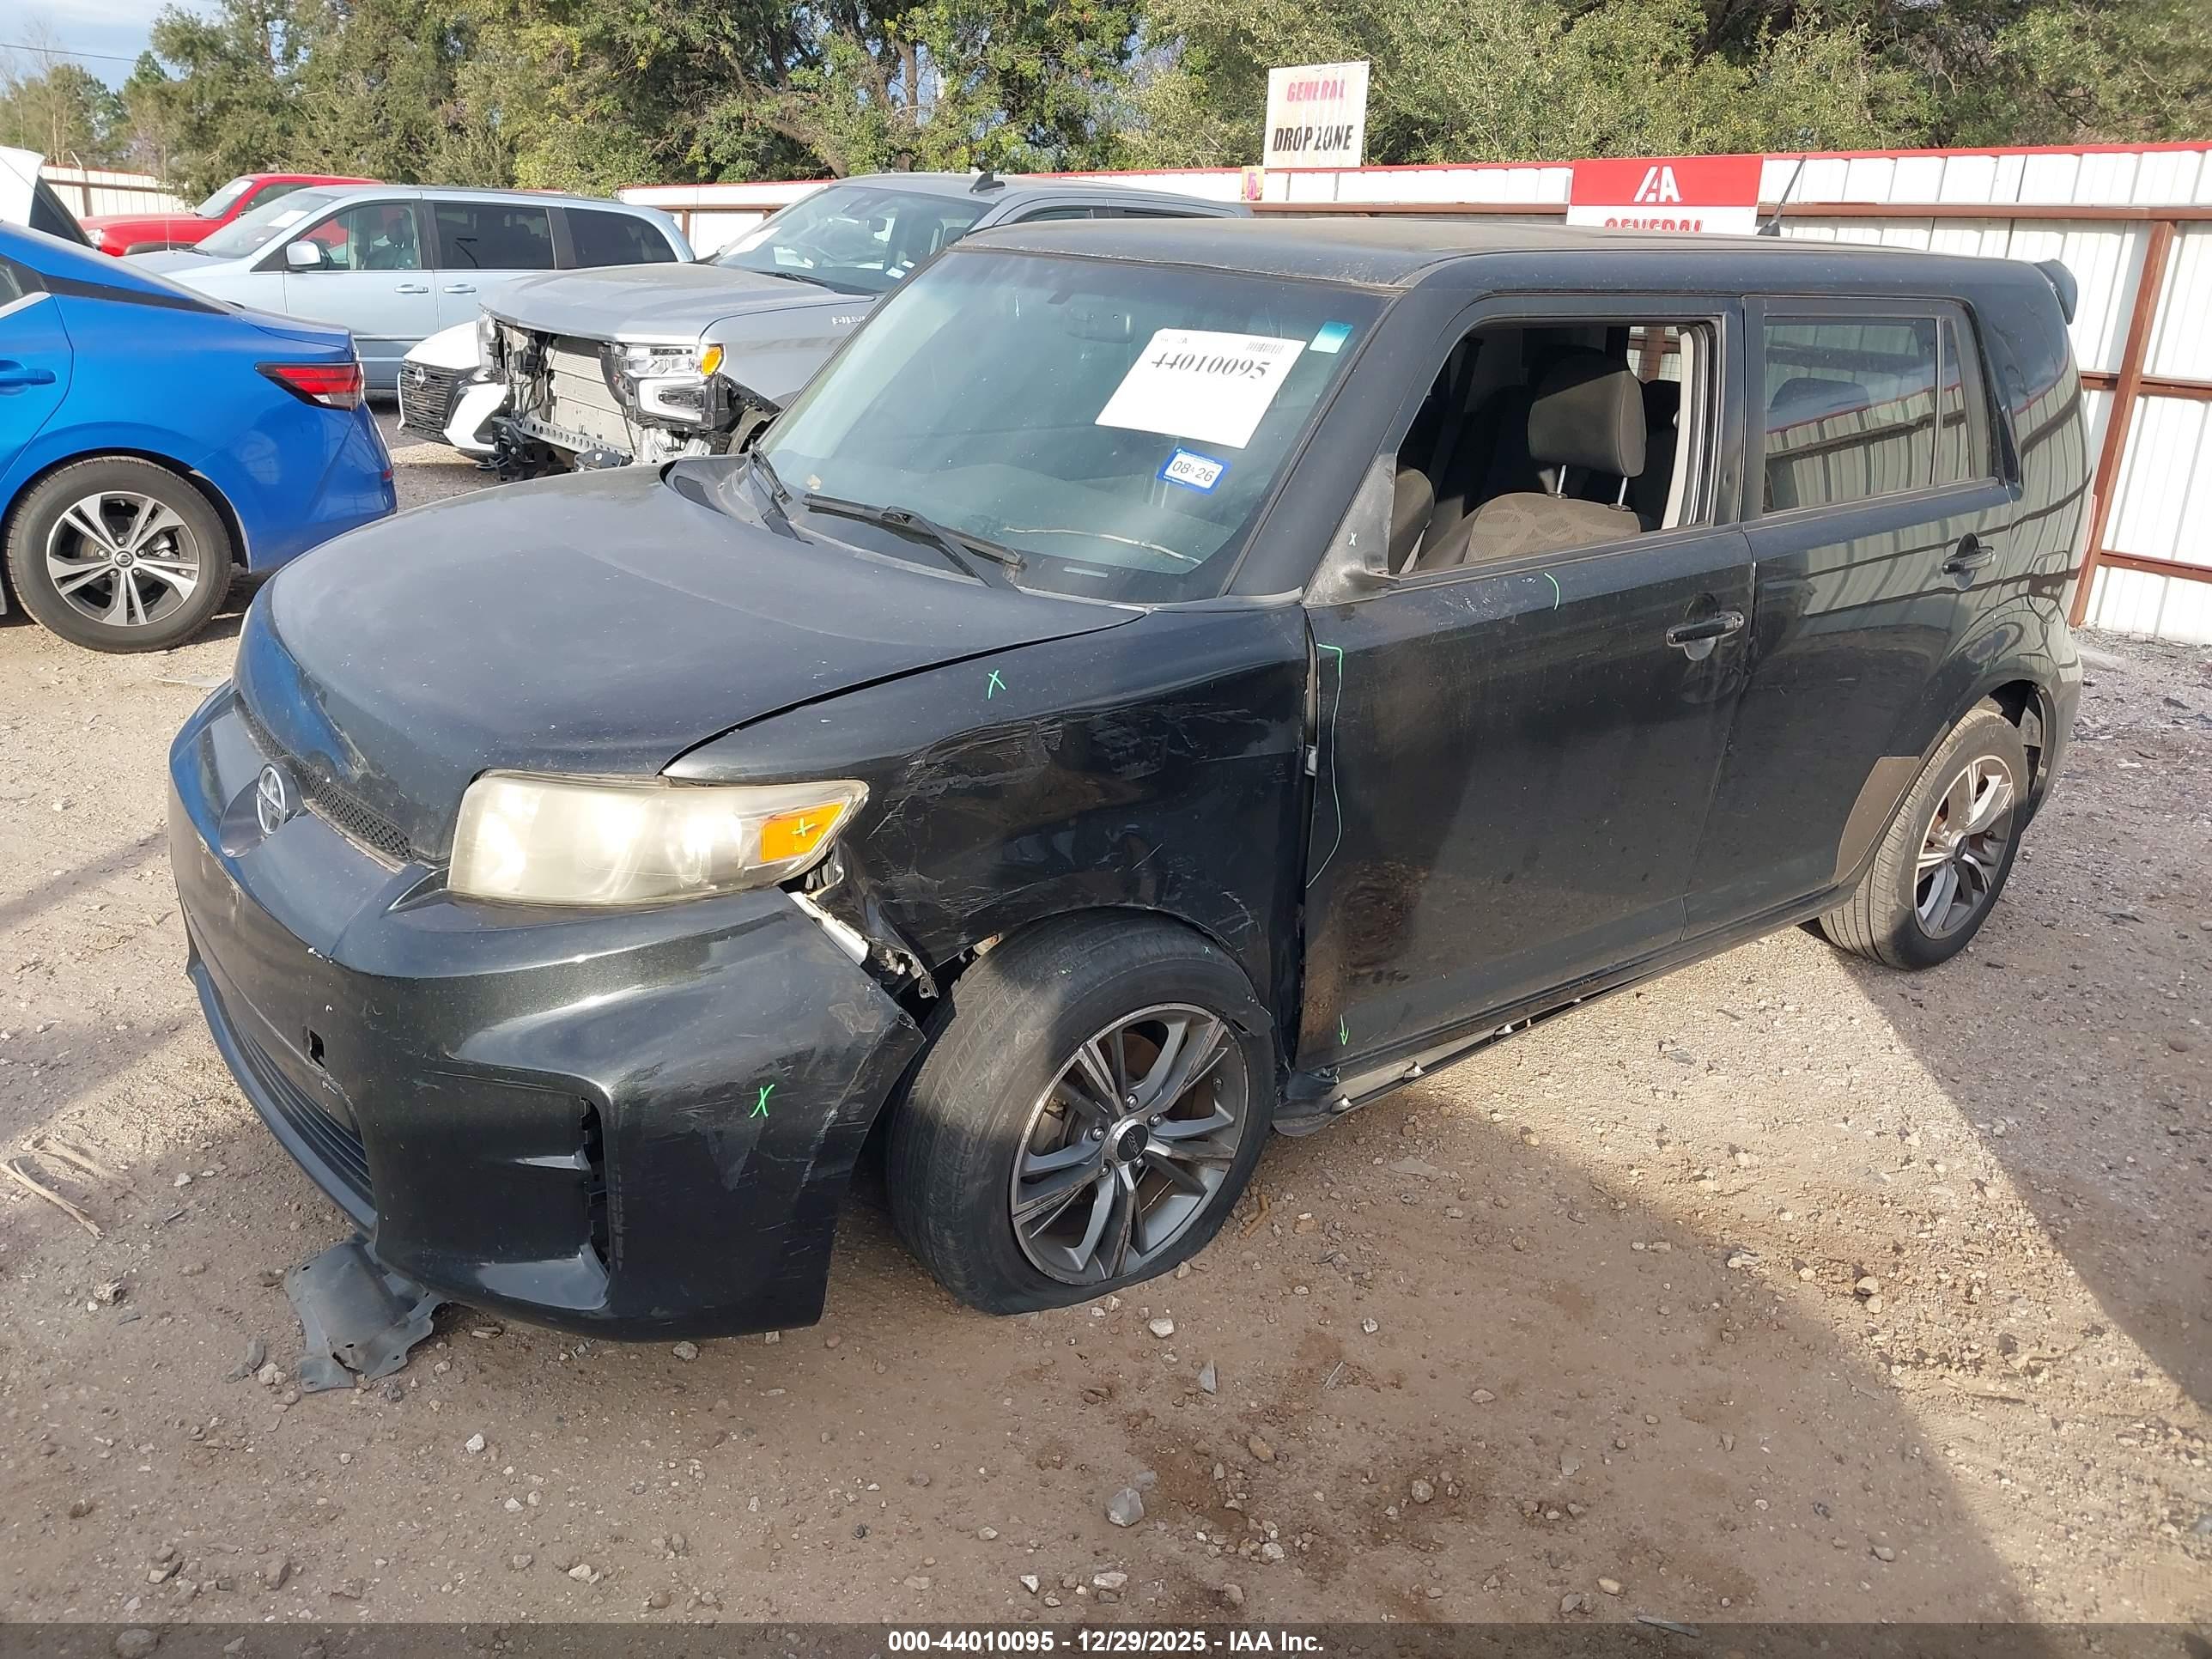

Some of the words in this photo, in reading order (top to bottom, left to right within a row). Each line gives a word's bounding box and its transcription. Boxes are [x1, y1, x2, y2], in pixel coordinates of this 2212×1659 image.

[1286, 79, 1346, 102] GENERAL
[1272, 126, 1314, 152] DROP
[1313, 125, 1354, 151] ZONE
[1151, 351, 1272, 380] 44010095
